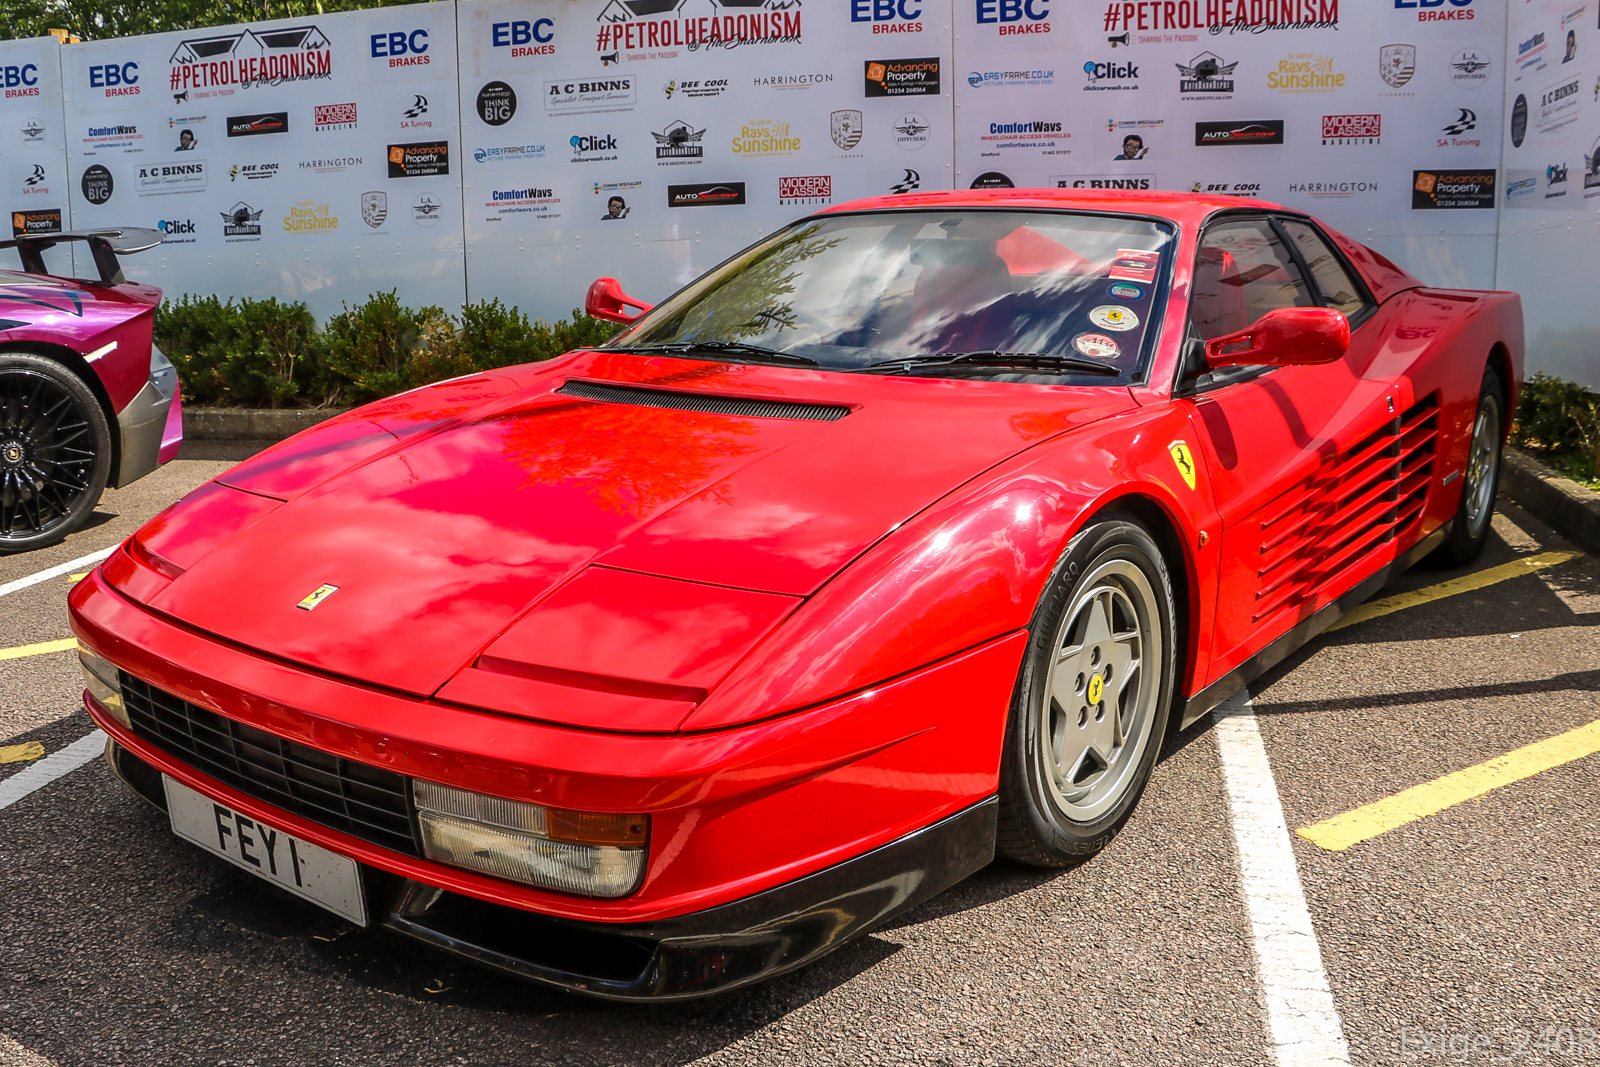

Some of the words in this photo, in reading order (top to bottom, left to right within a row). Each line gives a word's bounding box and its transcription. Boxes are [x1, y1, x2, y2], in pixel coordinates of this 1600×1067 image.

[851, 0, 922, 22] EBC
[976, 0, 1050, 24] EBC
[1104, 0, 1339, 31] #PETROLHEADONISM
[1418, 9, 1475, 21] BRAKES
[492, 18, 554, 47] EBC
[597, 11, 801, 51] #PETROLHEADONISM
[873, 22, 923, 34] BRAKES
[999, 22, 1051, 36] BRAKES
[370, 29, 429, 58] EBC
[511, 45, 555, 57] BRAKES
[389, 55, 430, 68] BRAKES
[887, 62, 938, 72] Advancing
[1278, 59, 1311, 73] Rays
[89, 61, 139, 88] EBC
[170, 49, 332, 91] #PETROLHEADONISM
[1095, 61, 1139, 79] Click
[753, 74, 833, 86] HARRINGTON
[887, 71, 926, 82] Property
[1267, 70, 1346, 88] Sunshine
[549, 85, 560, 95] A
[564, 84, 575, 94] C
[578, 80, 631, 93] BINNS
[680, 81, 700, 89] BEE
[704, 79, 729, 87] COOL
[5, 87, 40, 98] BRAKES
[105, 86, 141, 97] BRAKES
[1554, 80, 1579, 102] BINNS
[484, 99, 510, 107] THINK
[315, 105, 356, 115] MODERN
[485, 106, 511, 121] BIG
[315, 112, 357, 125] CLASSICS
[410, 120, 432, 128] Tuning
[1323, 115, 1380, 127] MODERN
[741, 126, 770, 139] Rays
[990, 121, 1062, 134] ComfortWavs
[1323, 125, 1380, 137] CLASSICS
[579, 135, 617, 152] Click
[731, 135, 801, 153] Sunshine
[1437, 139, 1449, 147] SA
[1451, 138, 1480, 147] Tuning
[405, 144, 447, 155] Advancing
[299, 157, 363, 169] HARRINGTON
[405, 153, 437, 164] Property
[139, 169, 148, 178] A
[150, 168, 159, 177] C
[162, 164, 202, 176] BINNS
[242, 164, 257, 172] BEE
[87, 180, 108, 188] THINK
[779, 176, 830, 188] MODERN
[1090, 179, 1149, 190] BINNS
[1437, 174, 1493, 185] Advancing
[779, 186, 830, 197] CLASSICS
[1233, 183, 1261, 191] COOL
[1289, 182, 1378, 192] HARRINGTON
[1437, 183, 1480, 193] Property
[88, 187, 109, 200] BIG
[492, 188, 552, 200] ComfortWavs
[26, 213, 60, 221] Advancing
[291, 206, 314, 219] Rays
[26, 220, 52, 228] Property
[163, 219, 196, 235] Click
[283, 215, 338, 231] Sunshine
